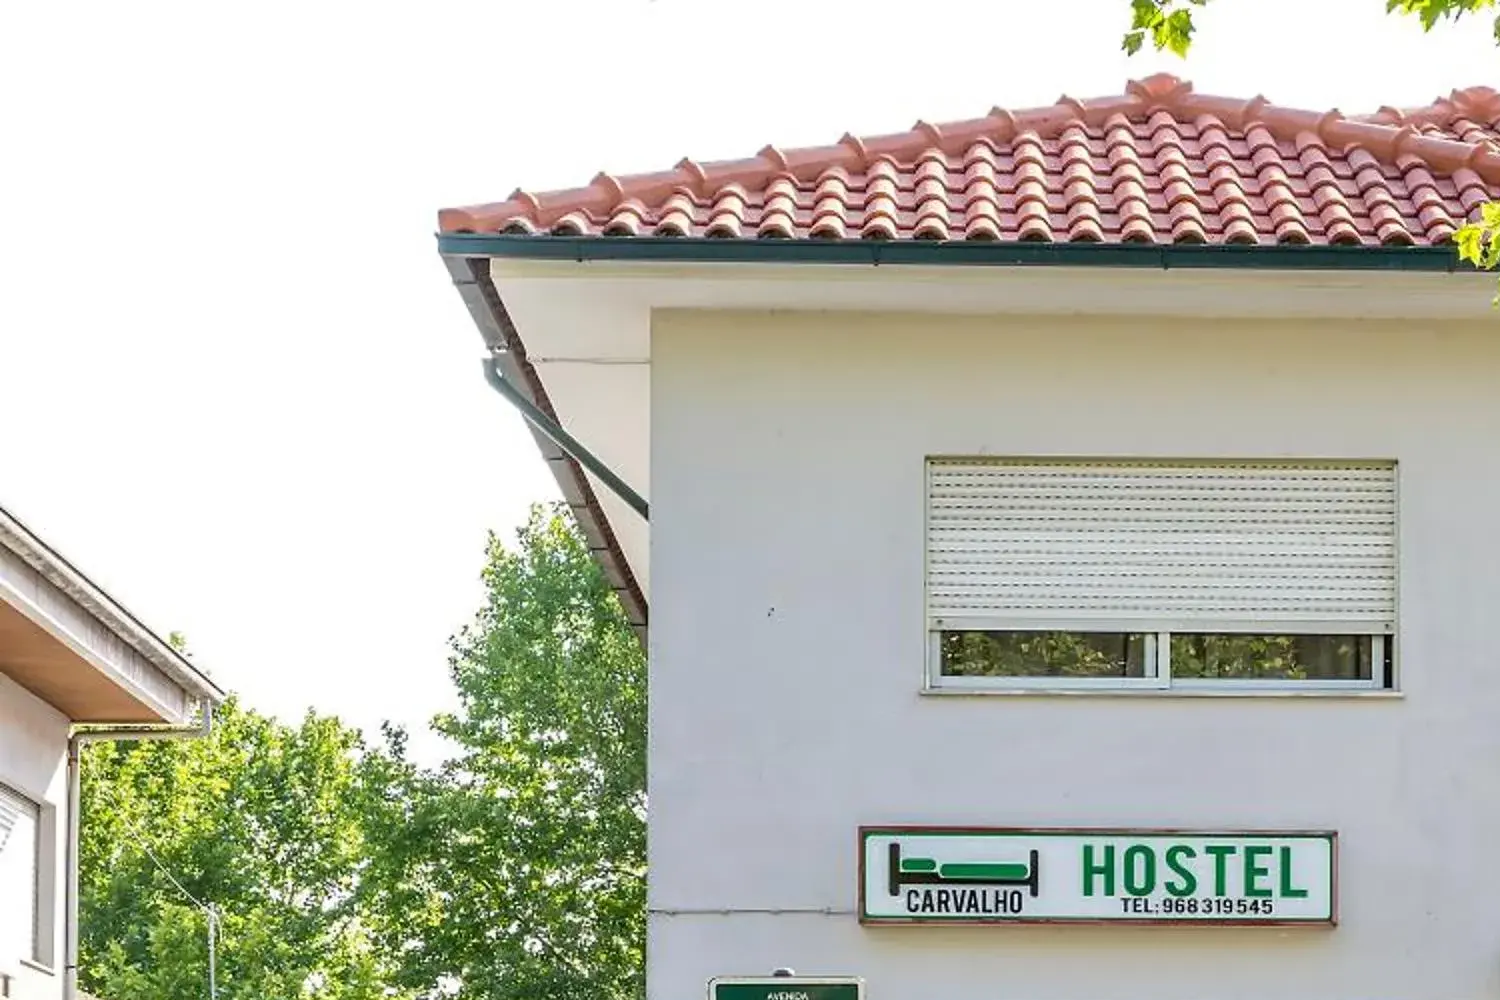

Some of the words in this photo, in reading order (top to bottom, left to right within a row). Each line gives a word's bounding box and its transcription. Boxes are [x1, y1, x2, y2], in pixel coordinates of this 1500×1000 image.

[1082, 845, 1308, 898] HOSTEL
[906, 889, 1024, 914] CARVALHO
[767, 991, 809, 1000] AVENIDA
